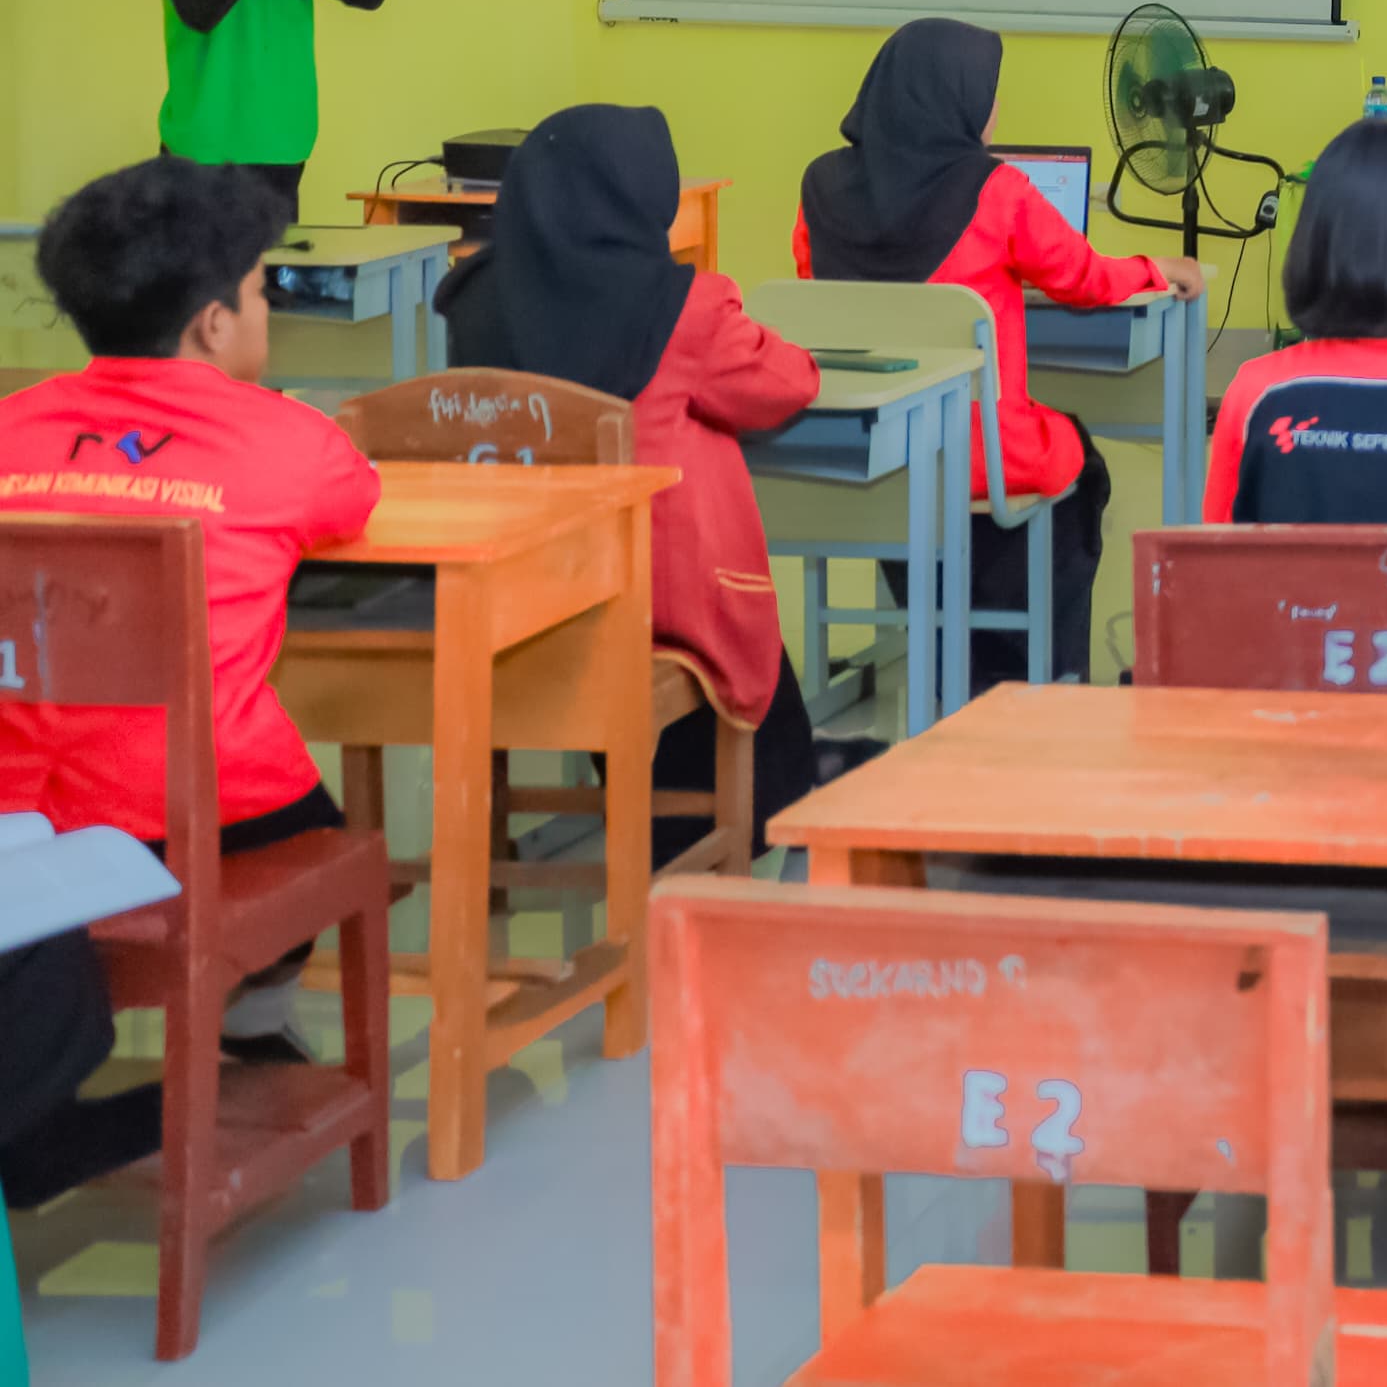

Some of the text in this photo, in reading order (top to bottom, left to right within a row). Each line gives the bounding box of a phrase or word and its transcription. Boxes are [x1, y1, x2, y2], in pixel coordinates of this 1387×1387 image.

[1292, 429, 1349, 448] TEKNIK
[0, 472, 225, 512] ESAIN KOMUNIKASI VISUAL
[1323, 630, 1355, 685] E
[961, 1069, 1085, 1156] E 2
